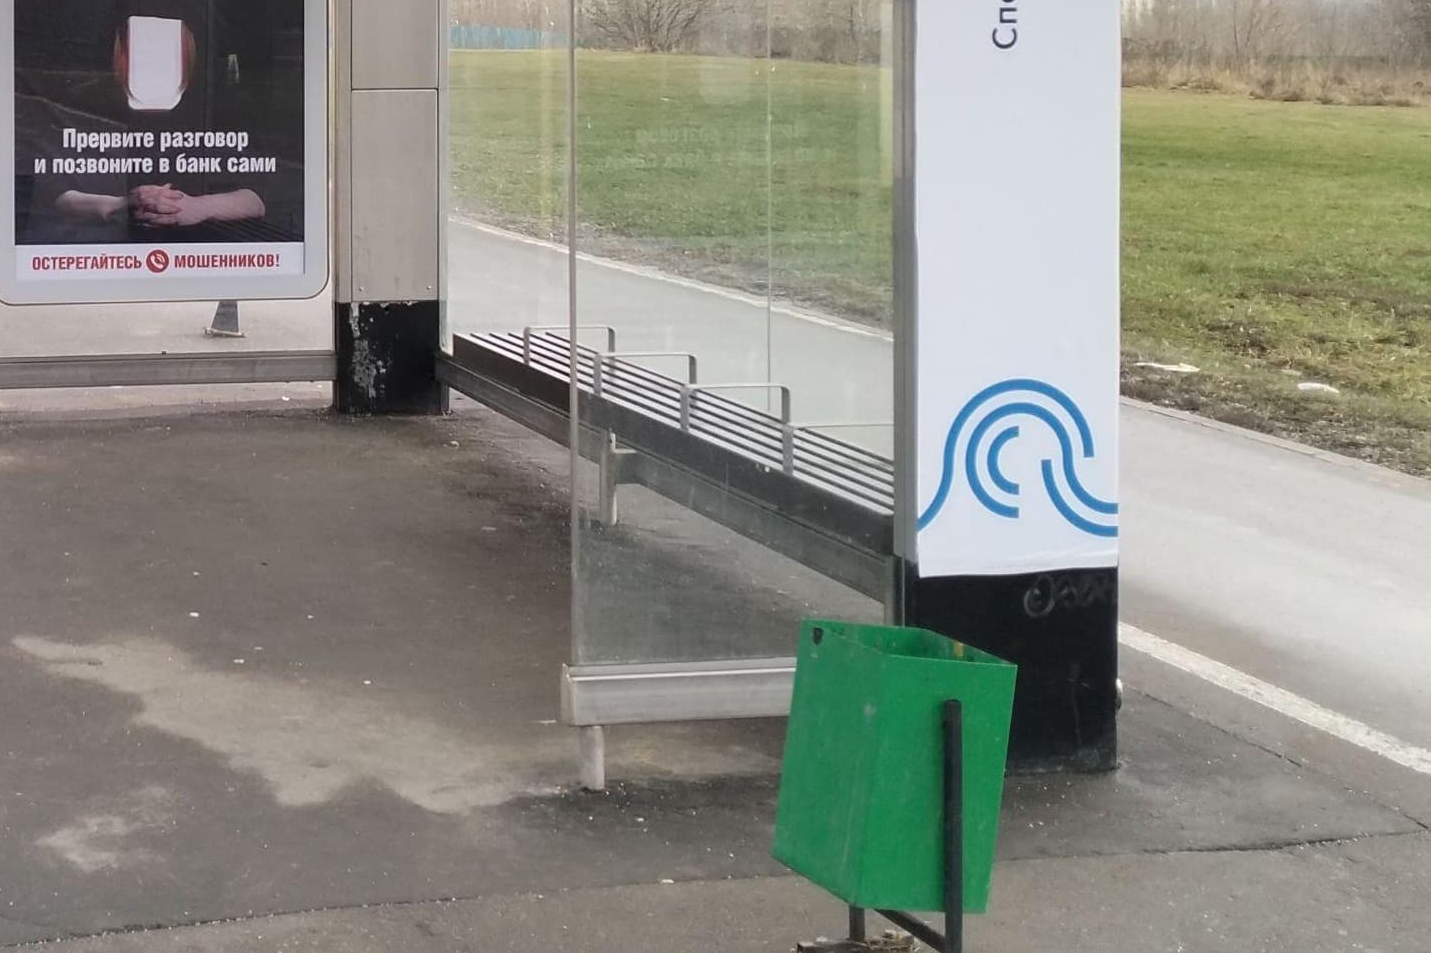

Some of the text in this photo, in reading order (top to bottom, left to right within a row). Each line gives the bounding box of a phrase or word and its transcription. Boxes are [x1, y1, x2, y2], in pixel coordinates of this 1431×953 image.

[62, 128, 249, 153] Прервите разговор
[34, 153, 277, 174] и позвоните в банк сами
[32, 253, 280, 271] ОСТЕРЕГАЙТЕСЬ МОШЕННИКОВ!
